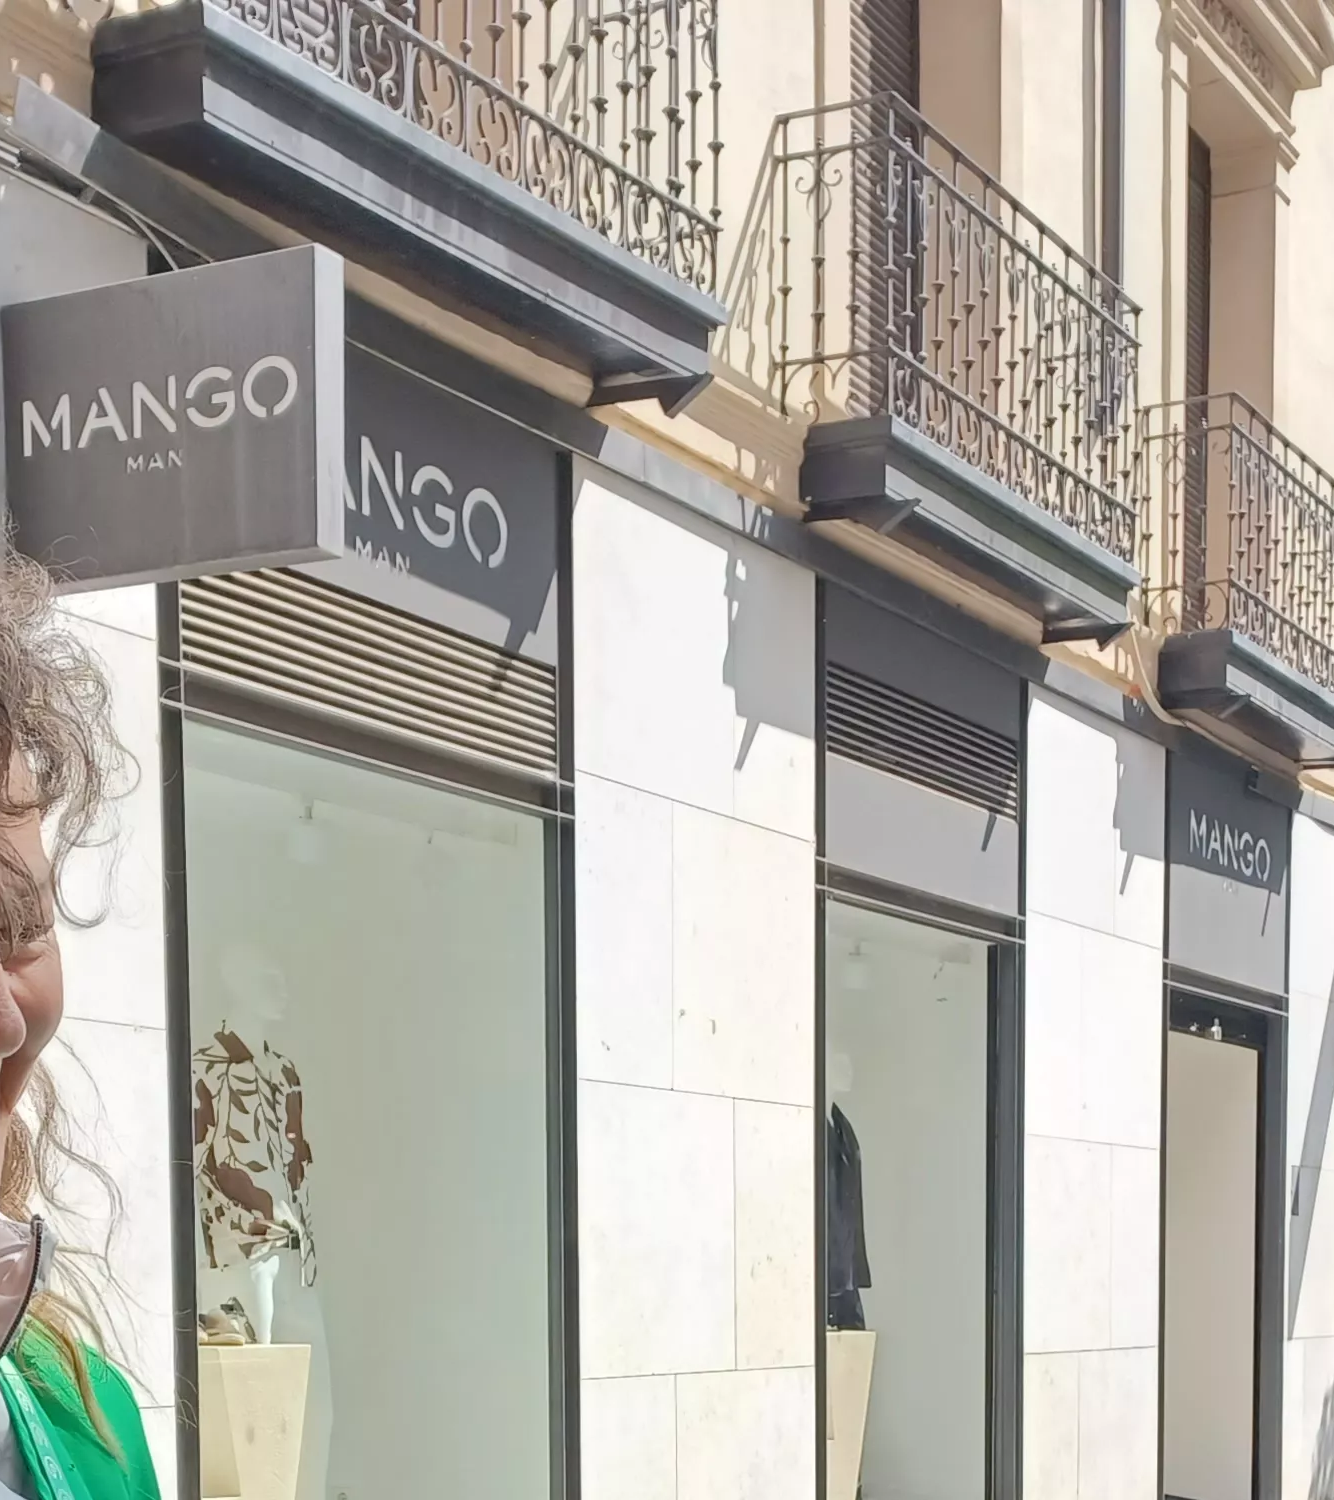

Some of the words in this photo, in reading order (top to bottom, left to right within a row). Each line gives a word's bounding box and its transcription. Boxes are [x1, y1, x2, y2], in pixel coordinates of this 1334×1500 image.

[22, 354, 298, 457] MANGO
[126, 449, 184, 474] MAN
[343, 434, 508, 570] NGO
[355, 535, 411, 578] MAN
[1189, 808, 1271, 882] MANGO
